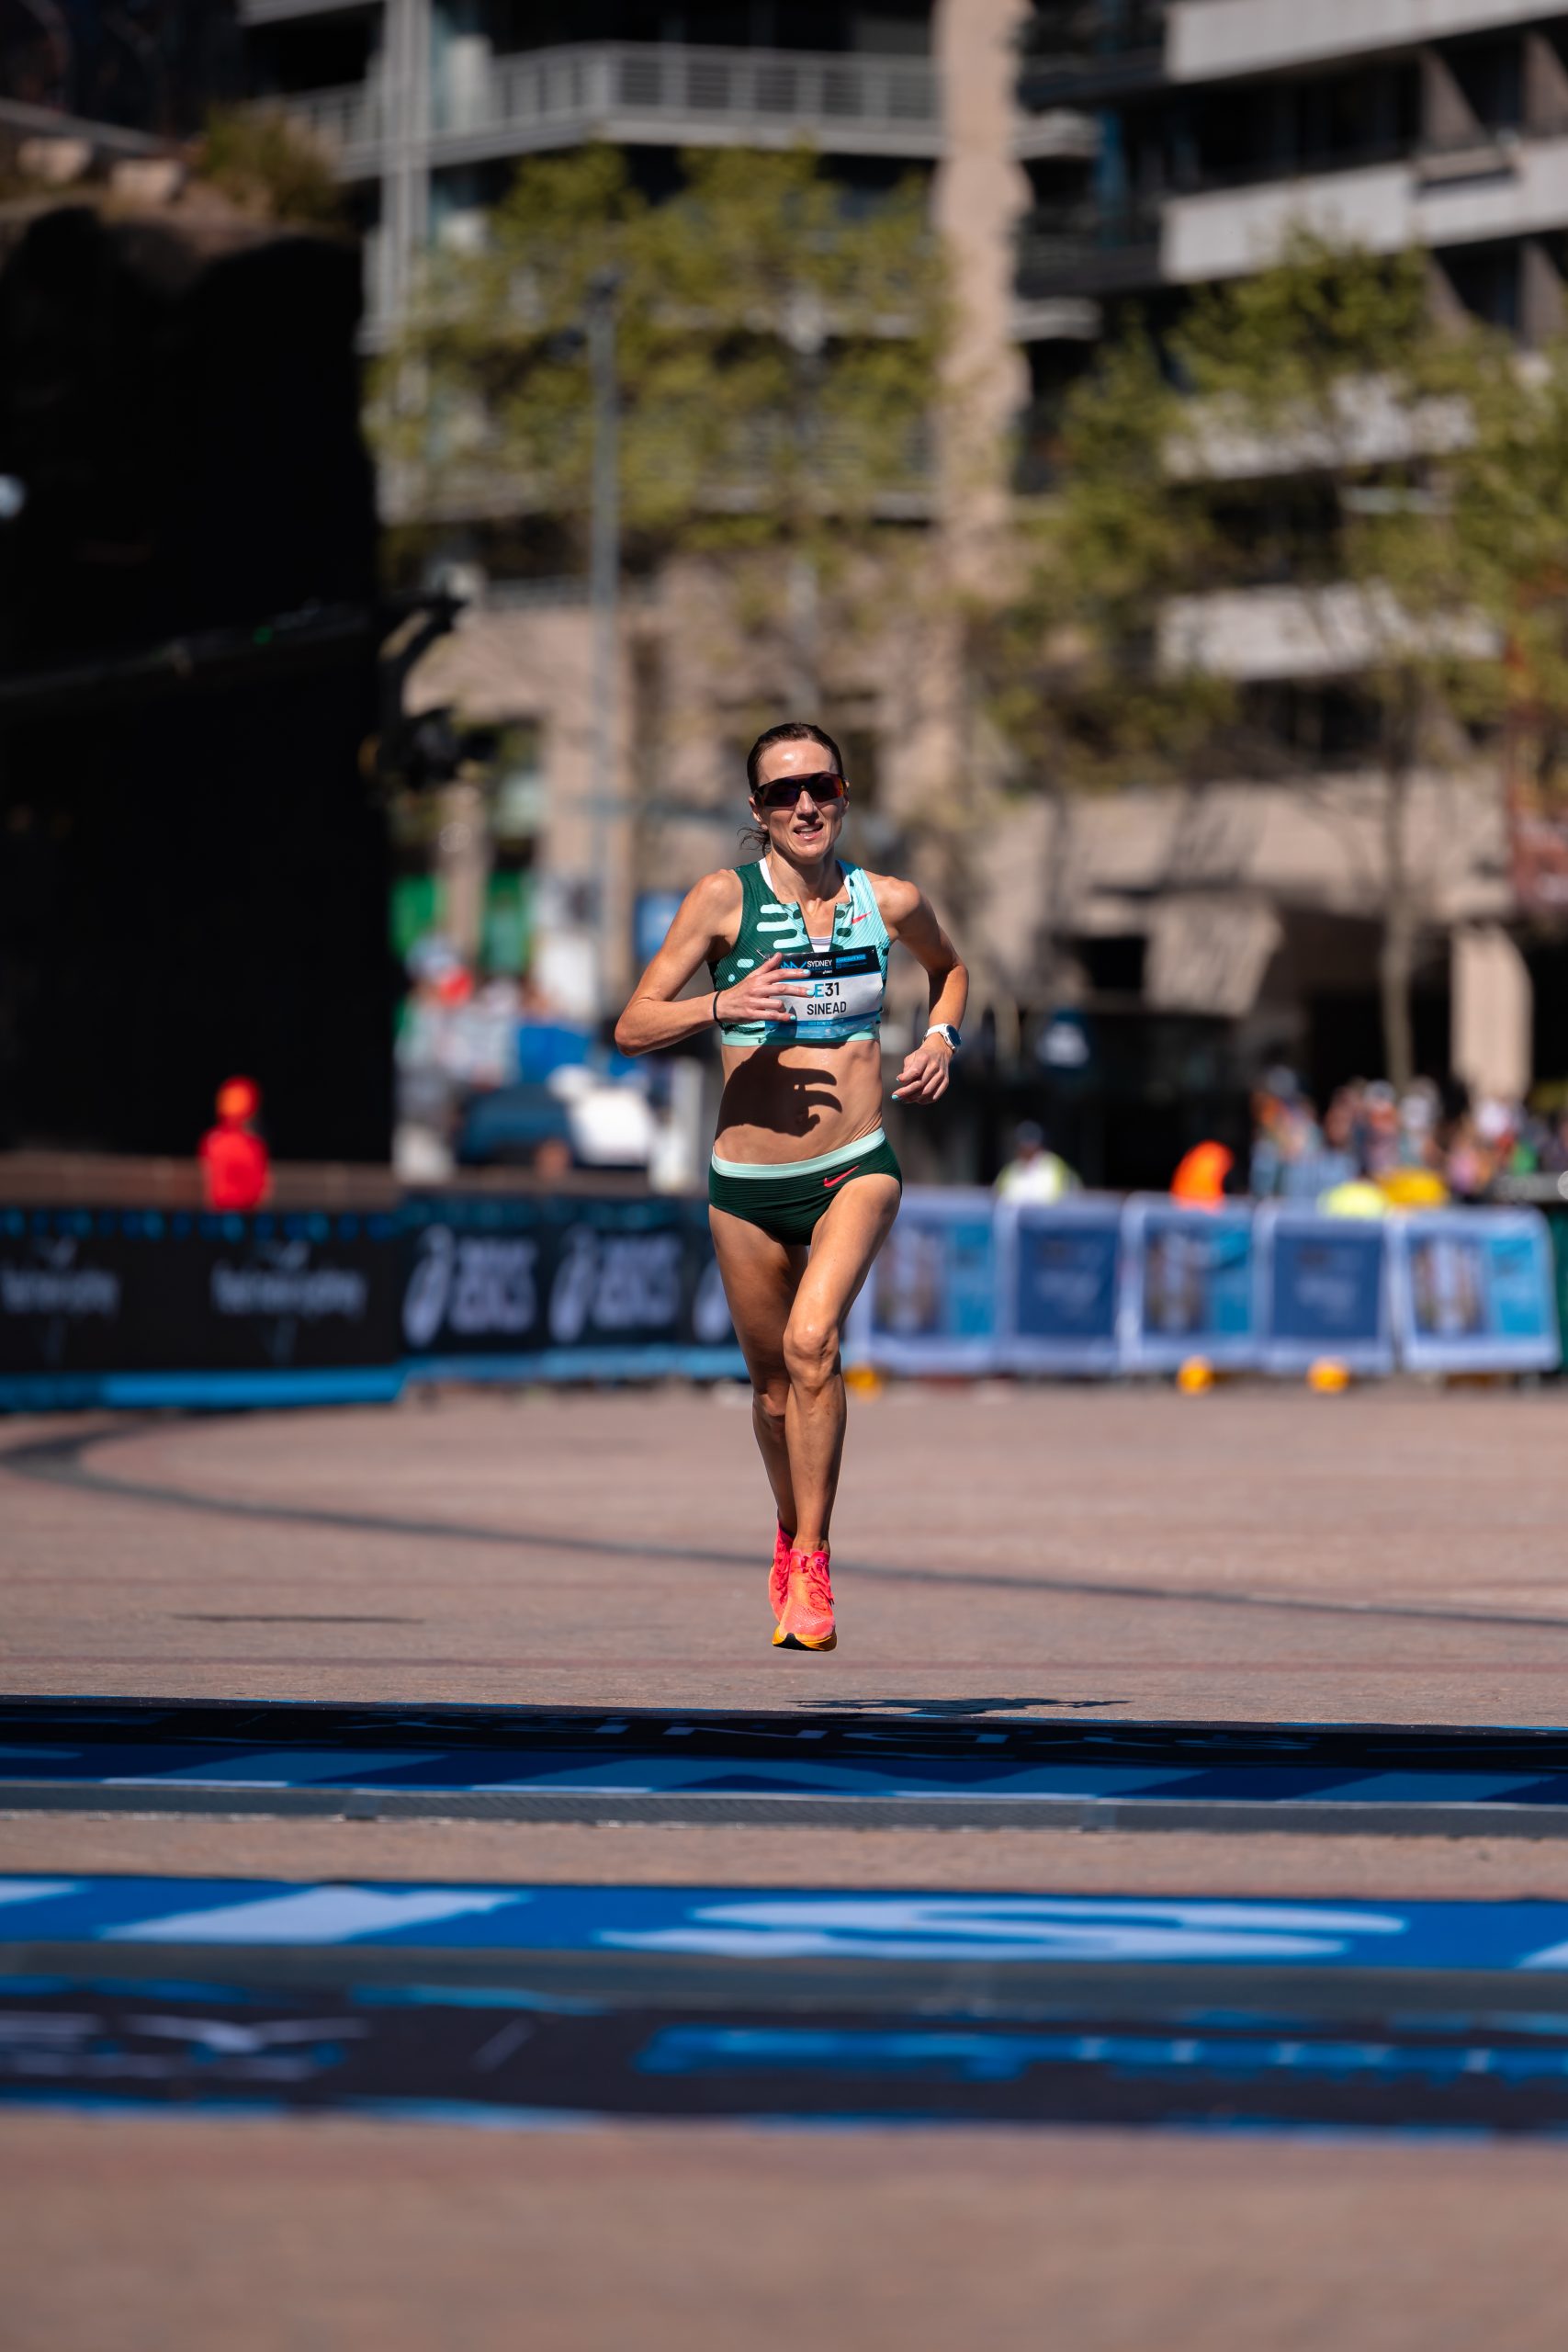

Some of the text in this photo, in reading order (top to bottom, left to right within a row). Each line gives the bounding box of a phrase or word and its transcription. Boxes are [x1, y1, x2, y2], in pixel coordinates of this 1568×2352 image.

[807, 959, 832, 967] SYDNEY
[815, 982, 840, 998] E31
[807, 1001, 847, 1015] SINEAD
